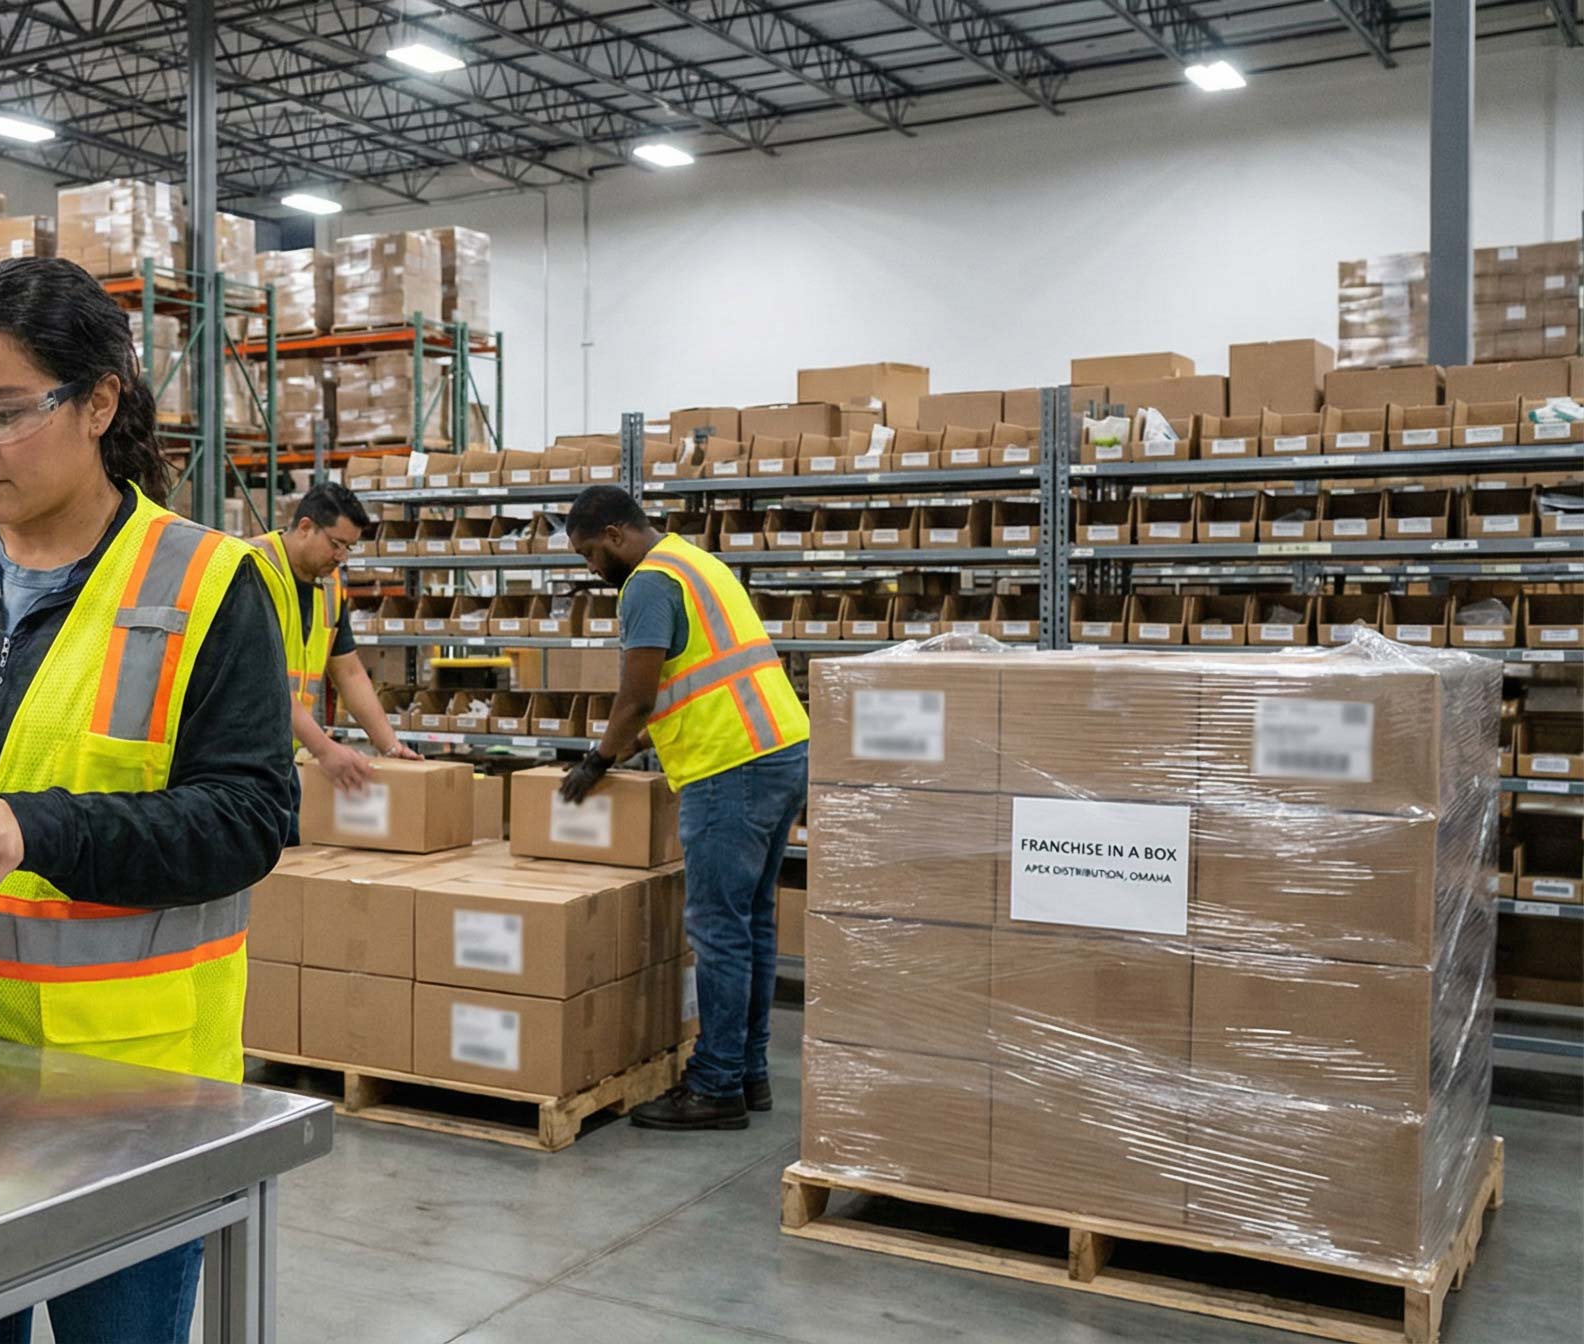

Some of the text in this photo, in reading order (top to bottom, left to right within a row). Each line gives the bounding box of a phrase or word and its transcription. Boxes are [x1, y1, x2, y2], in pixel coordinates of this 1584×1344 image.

[1021, 838, 1177, 862] FRANCHISE IN A BOX
[1024, 863, 1050, 874] APEX
[1129, 872, 1172, 883] OMAHA
